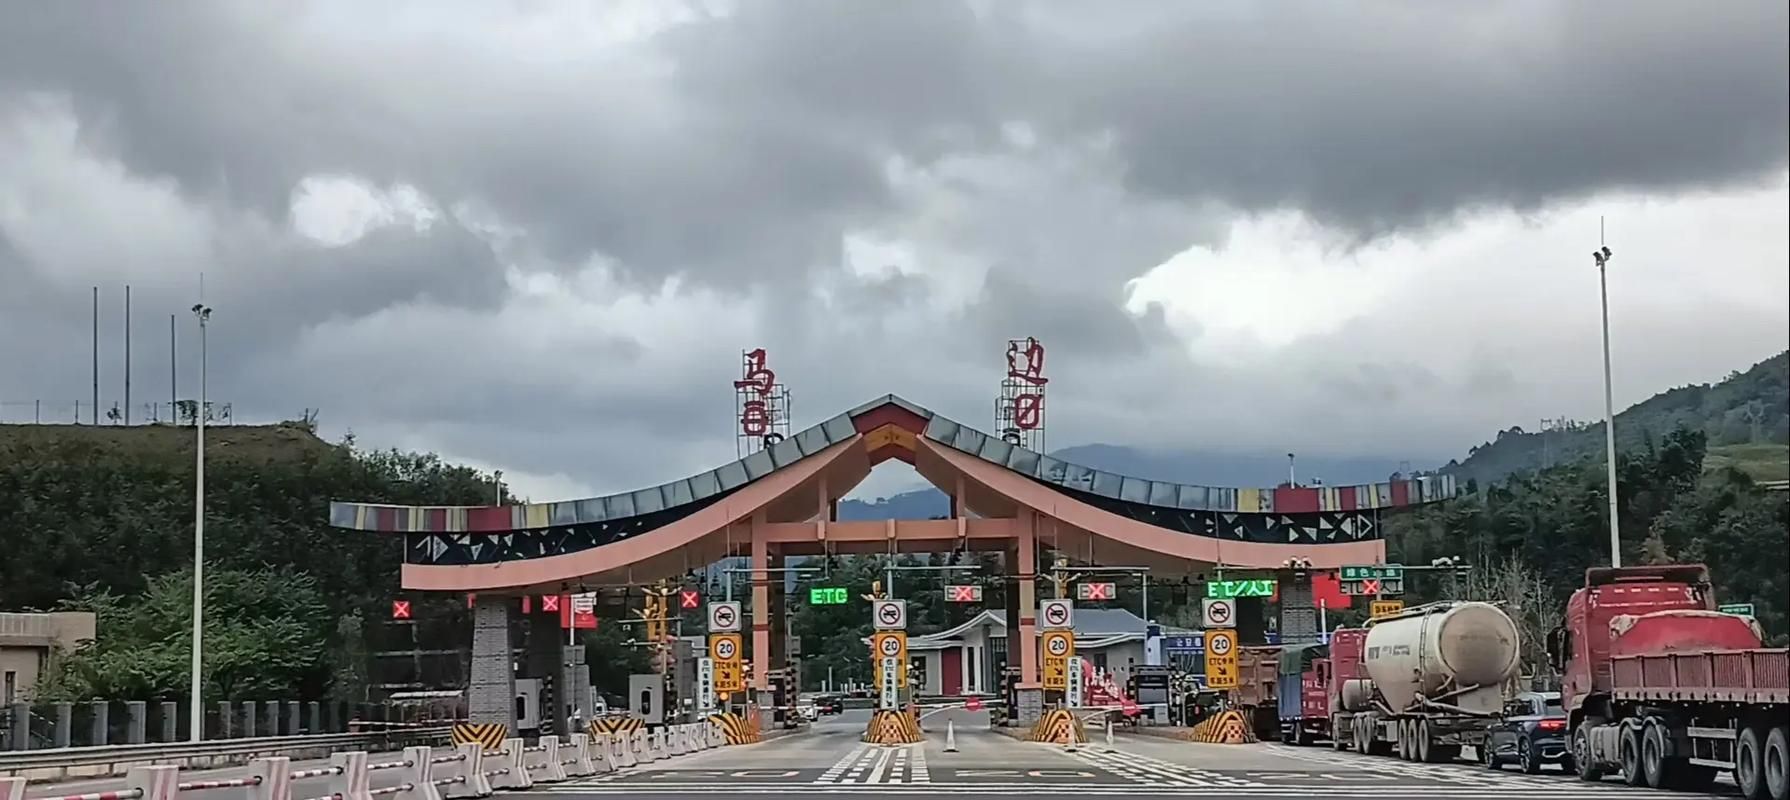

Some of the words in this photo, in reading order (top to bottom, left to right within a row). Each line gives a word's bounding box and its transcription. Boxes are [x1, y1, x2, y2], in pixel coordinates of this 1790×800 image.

[1006, 336, 1049, 385] 边
[733, 347, 776, 396] 马
[810, 588, 848, 604] ETC
[719, 643, 733, 654] 20
[884, 641, 898, 651] 20
[1051, 640, 1066, 651] 20
[1214, 639, 1228, 650] 20
